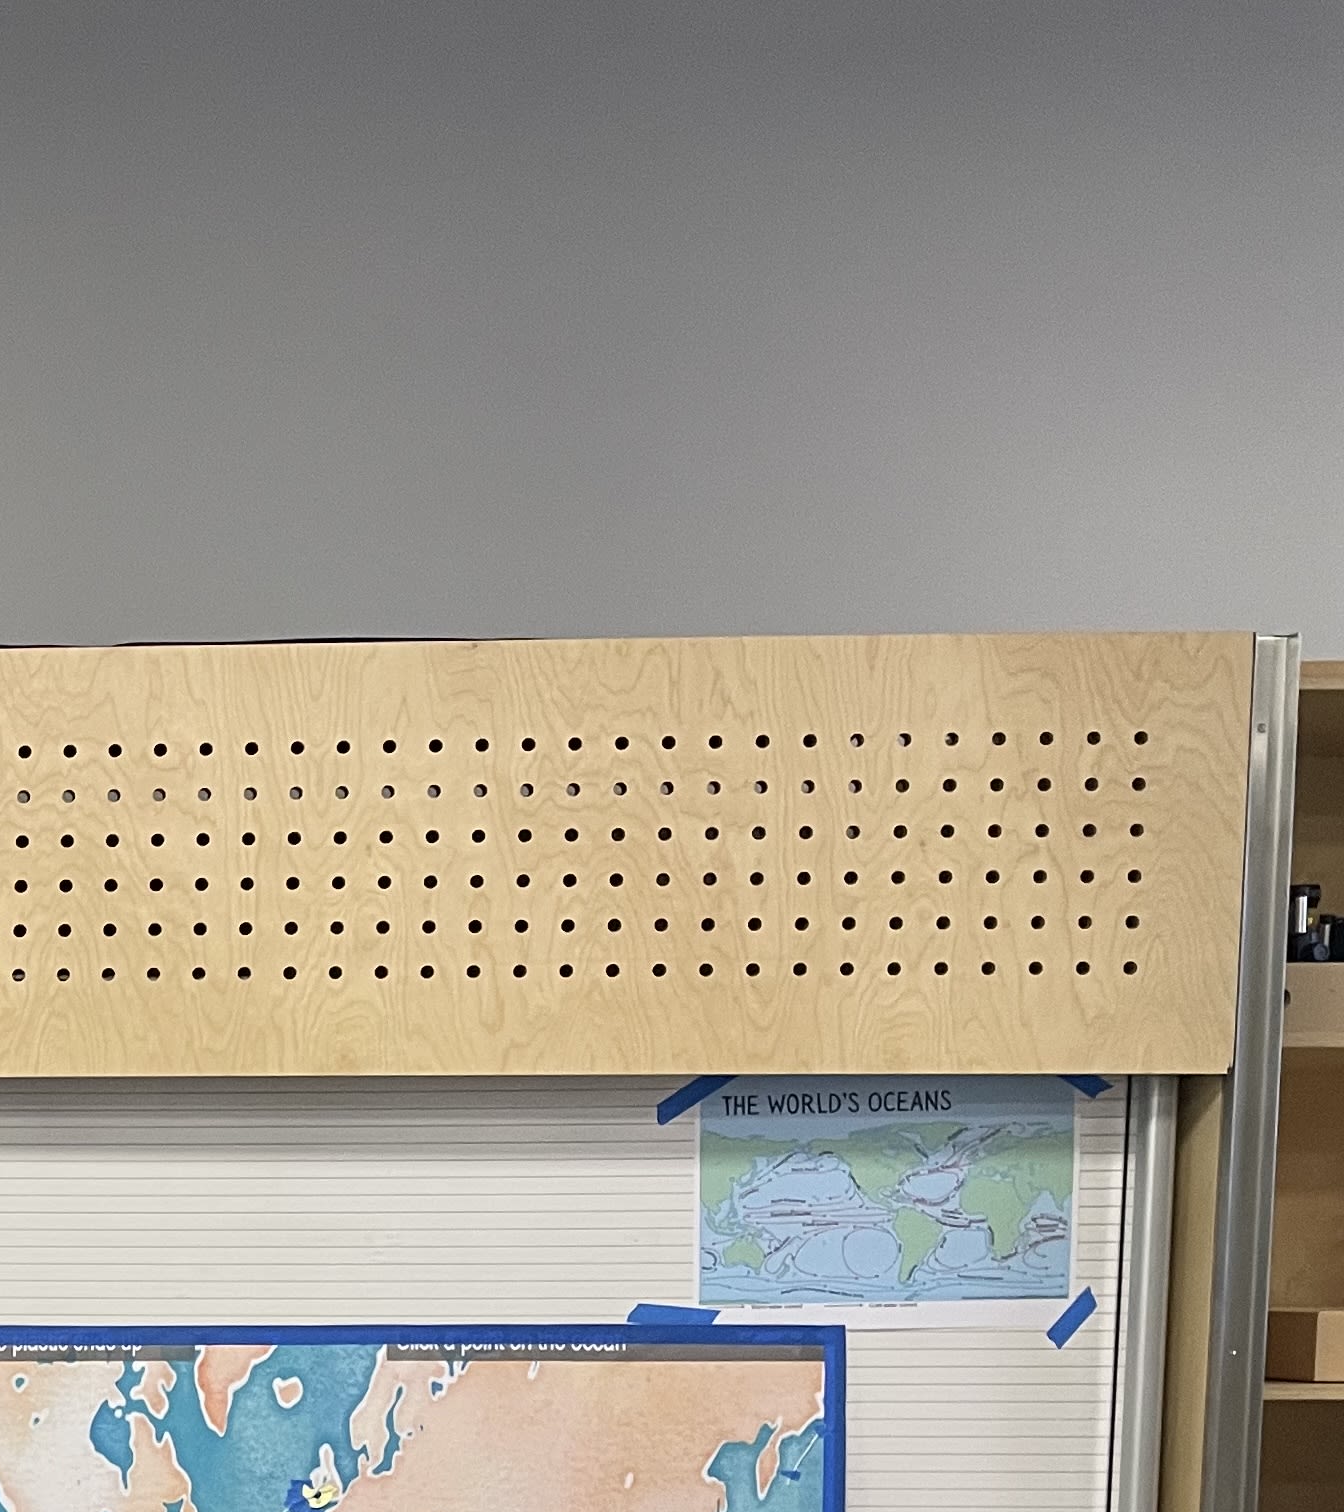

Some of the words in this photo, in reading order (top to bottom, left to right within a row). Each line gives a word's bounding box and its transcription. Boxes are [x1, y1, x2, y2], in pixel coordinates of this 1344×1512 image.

[722, 1095, 759, 1117] THE
[767, 1091, 859, 1116] WORLD'S
[868, 1089, 952, 1113] OCEANS
